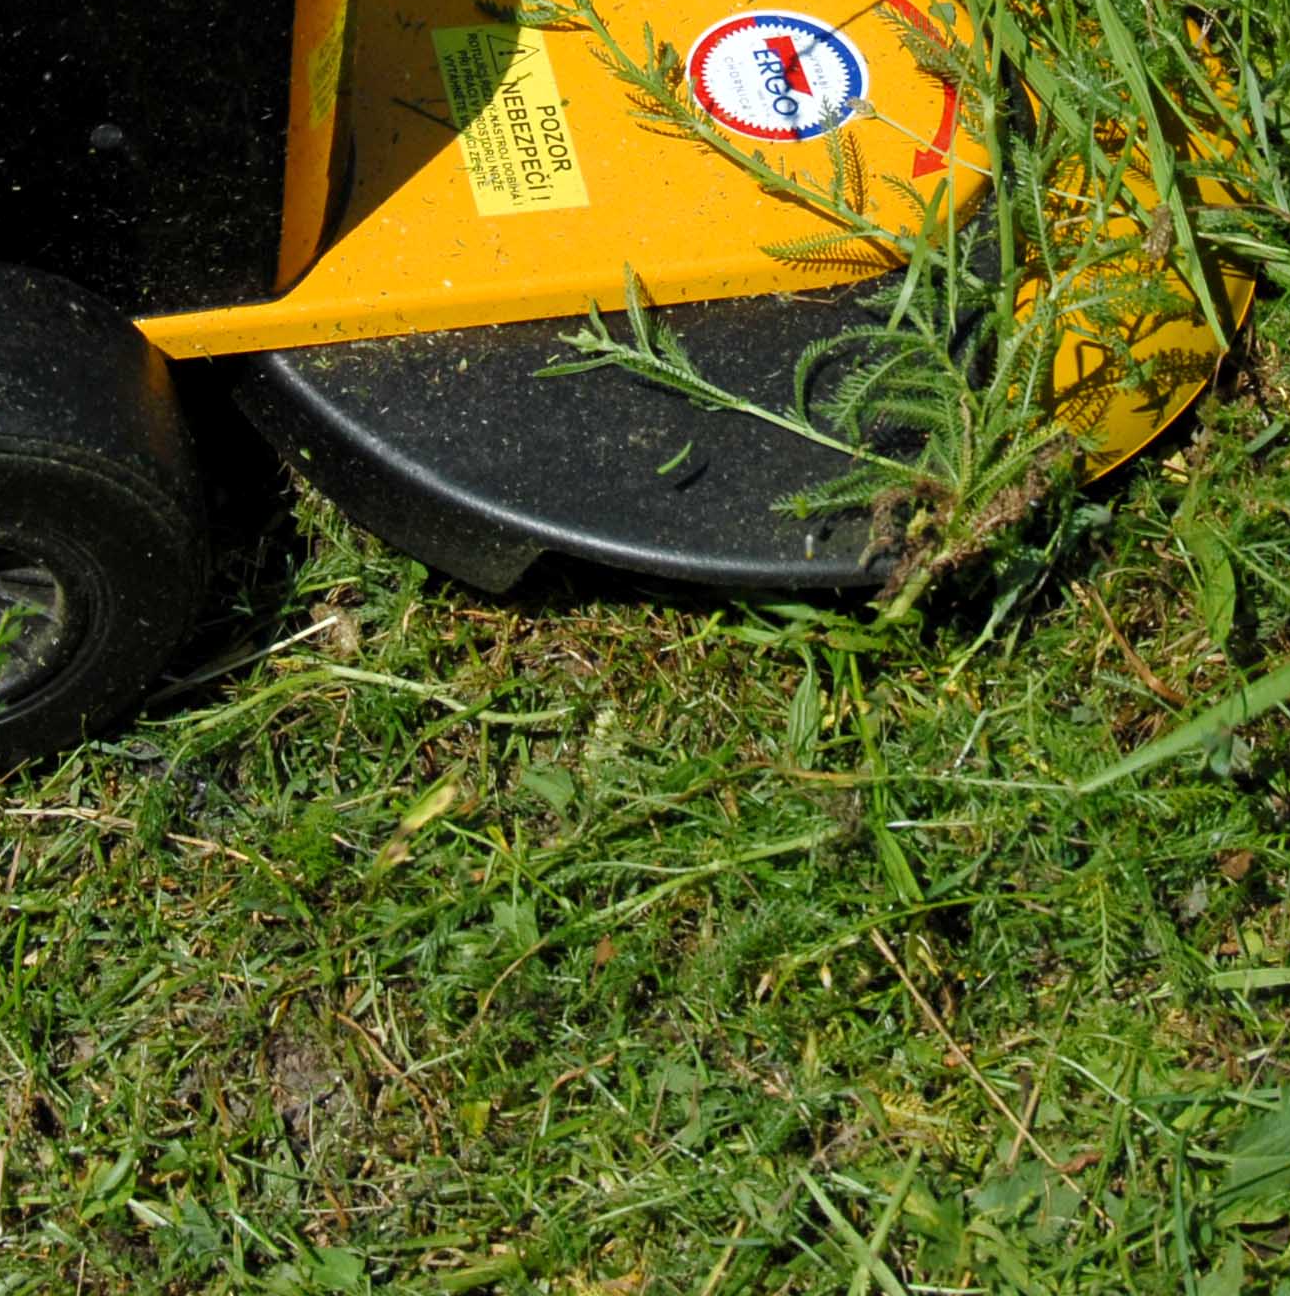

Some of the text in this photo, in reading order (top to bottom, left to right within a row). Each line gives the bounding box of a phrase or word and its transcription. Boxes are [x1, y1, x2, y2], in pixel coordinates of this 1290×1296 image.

[753, 48, 799, 116] ERGO
[500, 82, 554, 191] NEBEZPEČÍ
[536, 105, 572, 172] POZOR
